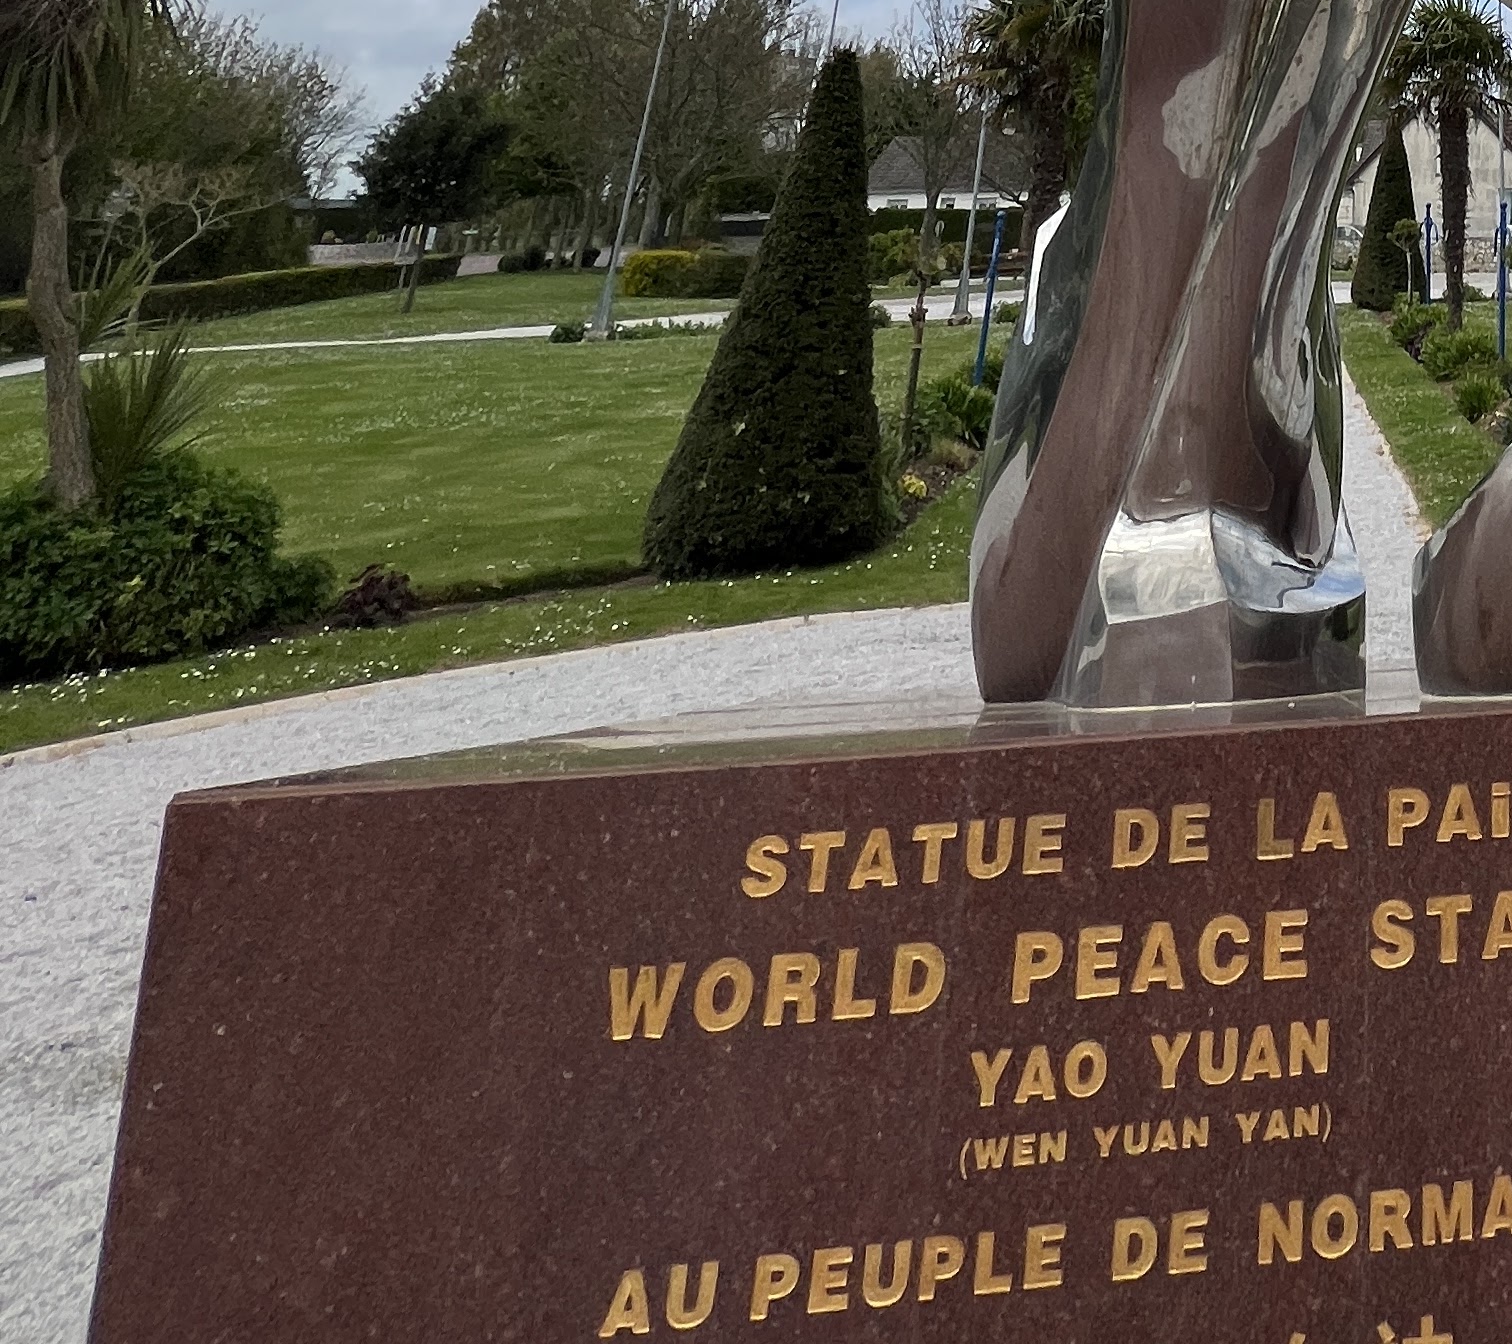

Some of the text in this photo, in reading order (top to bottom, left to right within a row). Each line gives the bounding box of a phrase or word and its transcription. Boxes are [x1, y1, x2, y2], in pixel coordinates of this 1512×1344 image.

[741, 815, 1066, 898] STATUE
[1113, 803, 1209, 869] DE
[1257, 791, 1348, 860] LA
[609, 942, 945, 1040] WORLD
[1011, 909, 1309, 1004] PEACE
[970, 1019, 1329, 1107] YAO YUAN
[959, 1101, 1332, 1180] (WEN YUAN YAN)
[598, 1260, 719, 1338] AU
[750, 1224, 1066, 1321] PEUPLE
[1111, 1210, 1208, 1281] DE
